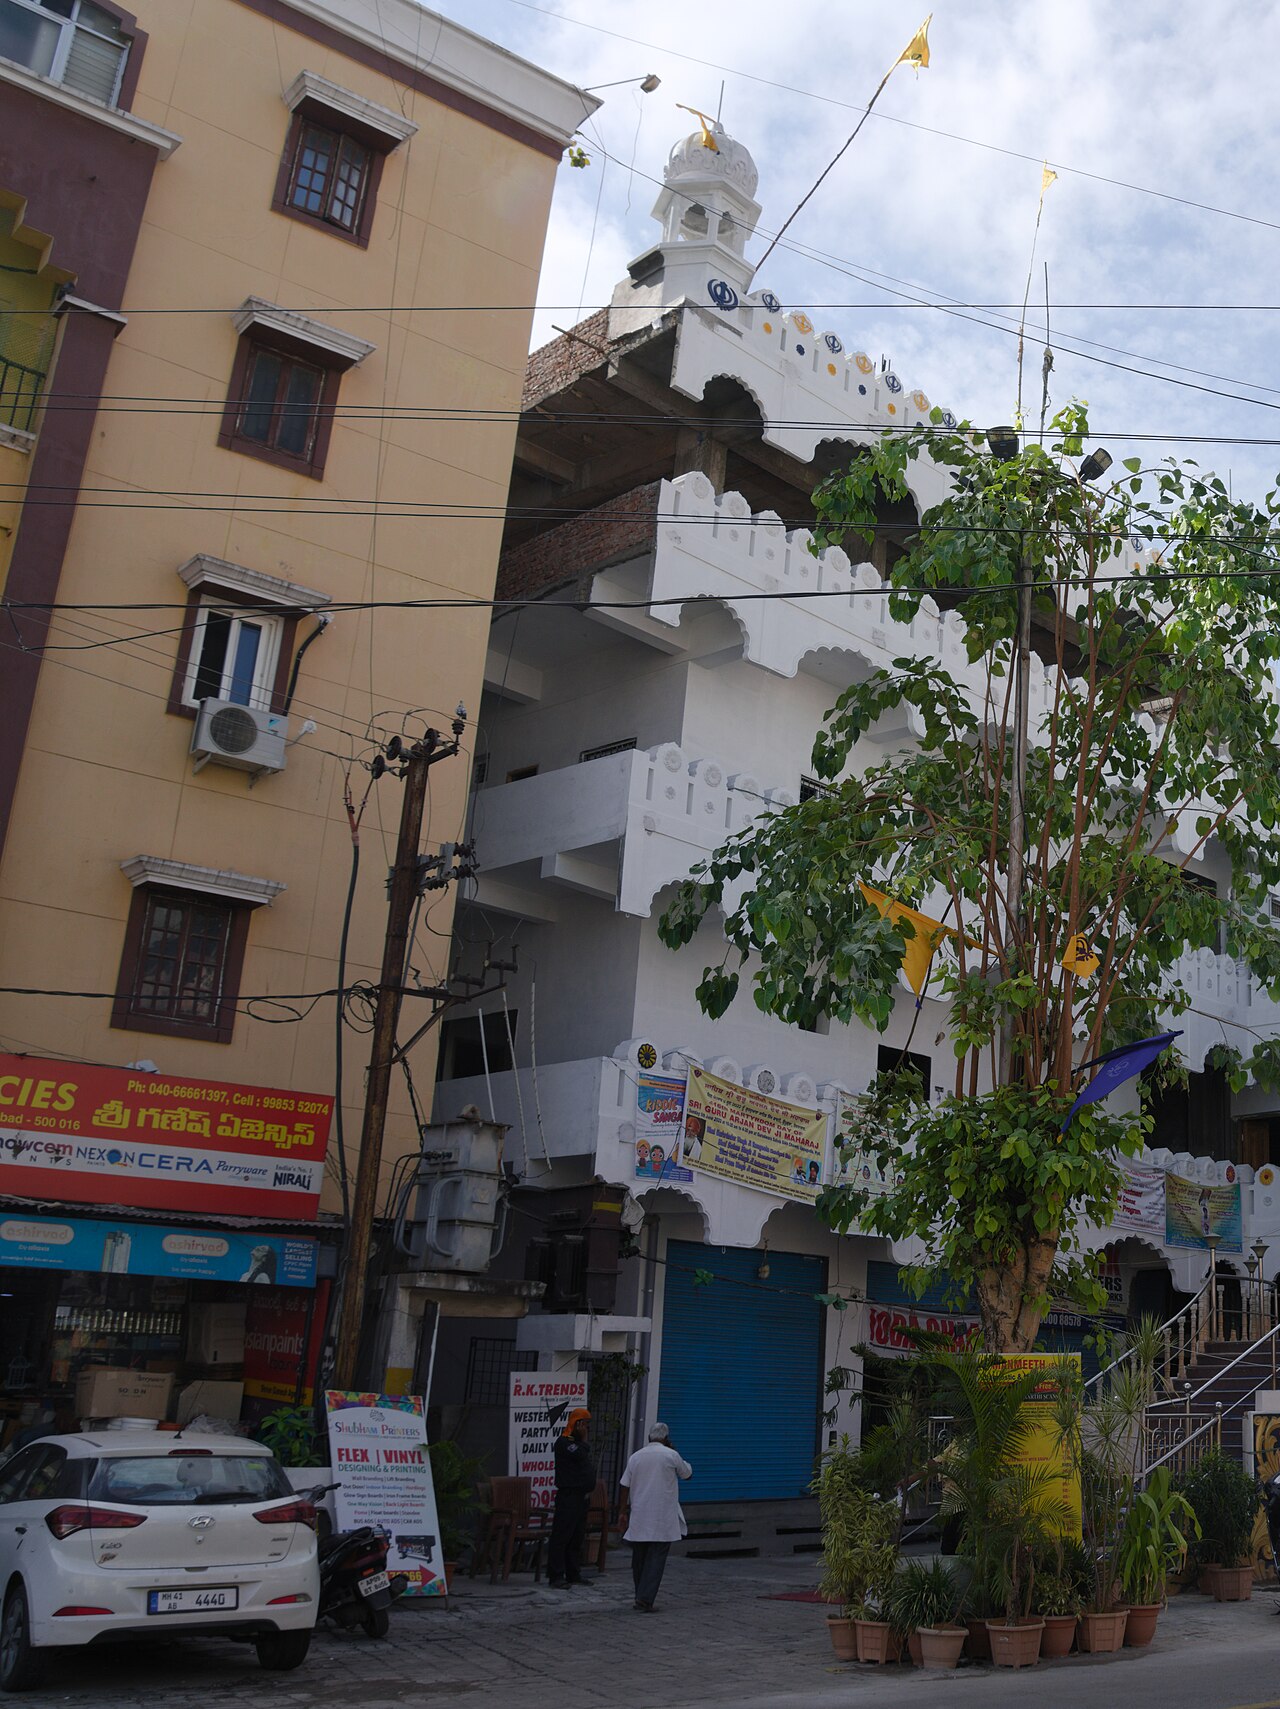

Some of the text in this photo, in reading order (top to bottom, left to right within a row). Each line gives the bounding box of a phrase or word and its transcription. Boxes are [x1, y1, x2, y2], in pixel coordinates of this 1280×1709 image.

[0, 1076, 78, 1111] CIES
[128, 1080, 146, 1093] Ph:
[149, 1084, 230, 1105] 040-66661397,
[232, 1093, 253, 1108] Cell
[263, 1097, 295, 1111] 99853
[297, 1101, 329, 1115] 52074
[34, 1116, 56, 1128] 500
[59, 1119, 80, 1130] 016
[688, 1099, 701, 1110] SRI
[704, 1104, 726, 1119] GURU
[729, 1113, 754, 1129] ARJAN
[756, 1123, 771, 1135] DEV
[773, 1128, 782, 1139] JI
[784, 1132, 819, 1150] MAHARAJ
[729, 1107, 775, 1128] MARTYRDOM
[777, 1123, 791, 1133] DAY
[138, 1153, 213, 1174] CERA
[216, 1160, 268, 1177] Parryware
[1059, 1314, 1081, 1327] 88578
[513, 1383, 585, 1396] R.K.TRENDS
[514, 1411, 549, 1422] WESTER
[521, 1427, 550, 1438] PARTY
[522, 1443, 549, 1453] DAILY
[337, 1448, 424, 1464] FLEX VINYL
[338, 1463, 381, 1473] DESIGNING
[391, 1465, 426, 1474] PRINTING
[522, 1461, 556, 1472] WHOLE
[532, 1476, 556, 1487] PRIC
[162, 1592, 183, 1601] MH 41
[195, 1593, 226, 1606] 4440
